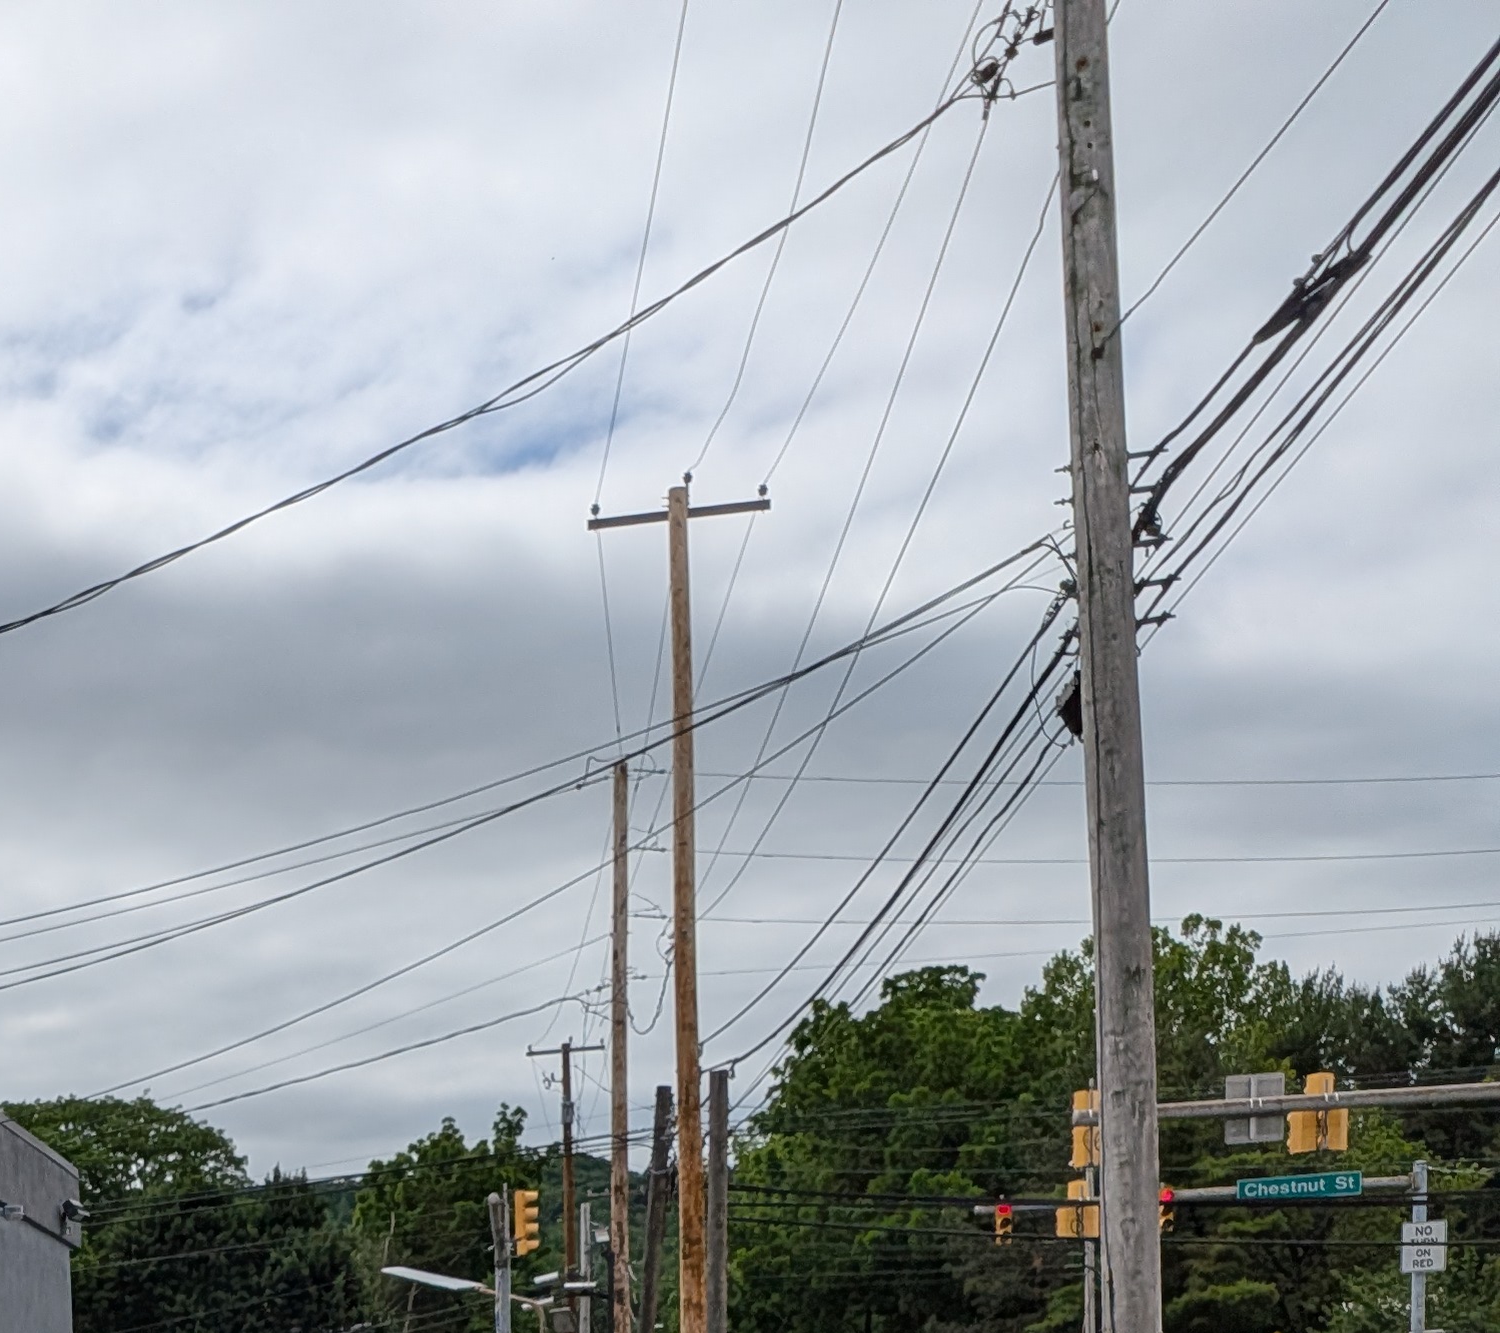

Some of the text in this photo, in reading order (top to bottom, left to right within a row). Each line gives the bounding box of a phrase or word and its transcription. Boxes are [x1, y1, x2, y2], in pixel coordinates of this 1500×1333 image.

[1244, 1175, 1356, 1198] Chestnut St
[1415, 1225, 1433, 1237] NO
[1415, 1248, 1431, 1258] ON
[1412, 1258, 1434, 1269] RED
